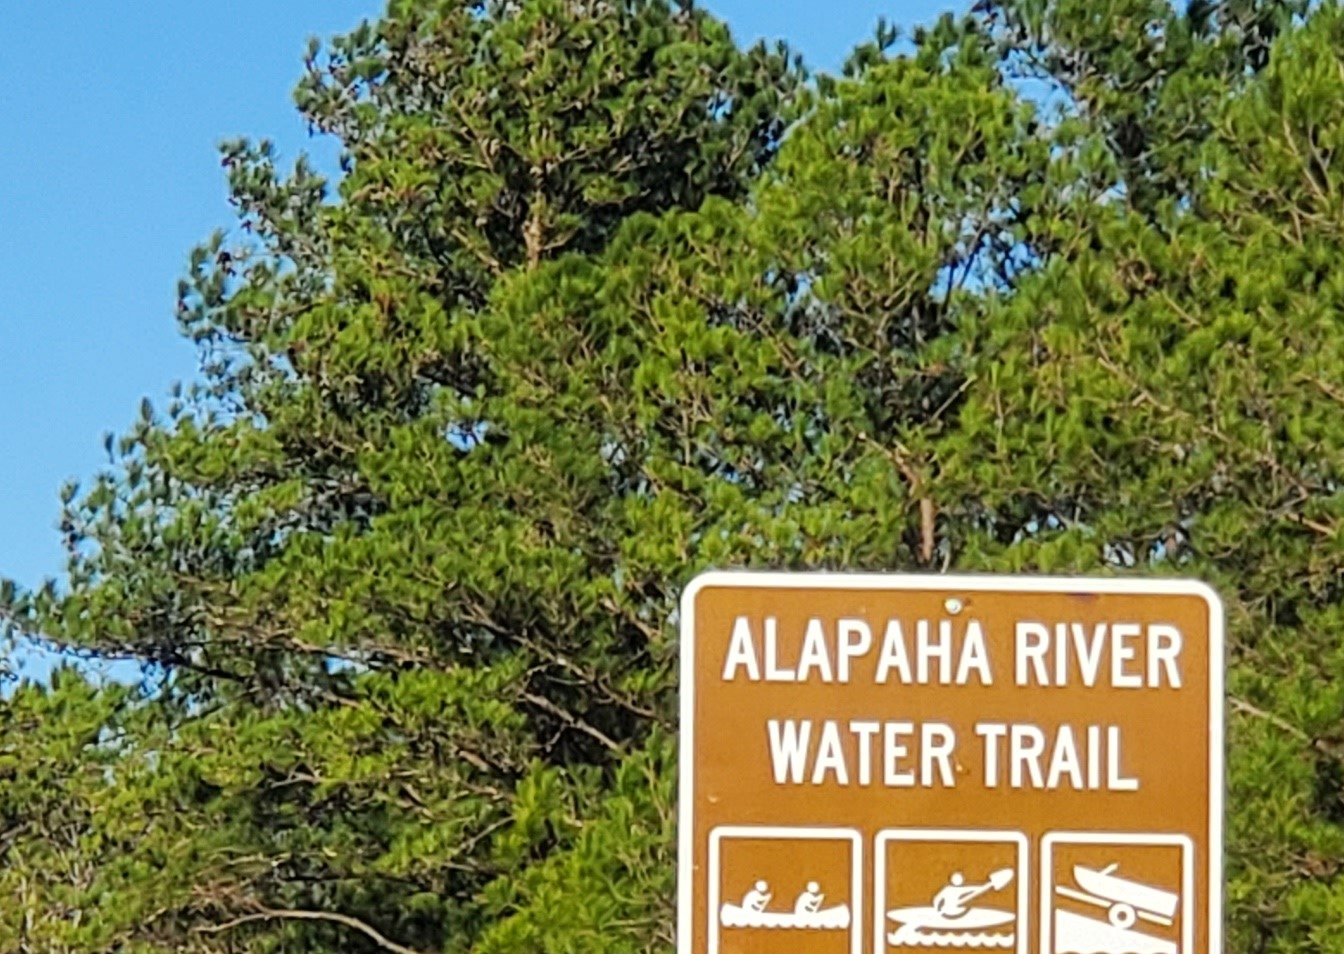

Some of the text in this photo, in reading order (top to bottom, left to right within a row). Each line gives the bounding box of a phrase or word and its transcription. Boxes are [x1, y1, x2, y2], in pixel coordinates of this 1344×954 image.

[721, 615, 1185, 689] ALAPAHA RIVER
[767, 718, 1141, 791] WATER TRAIL
